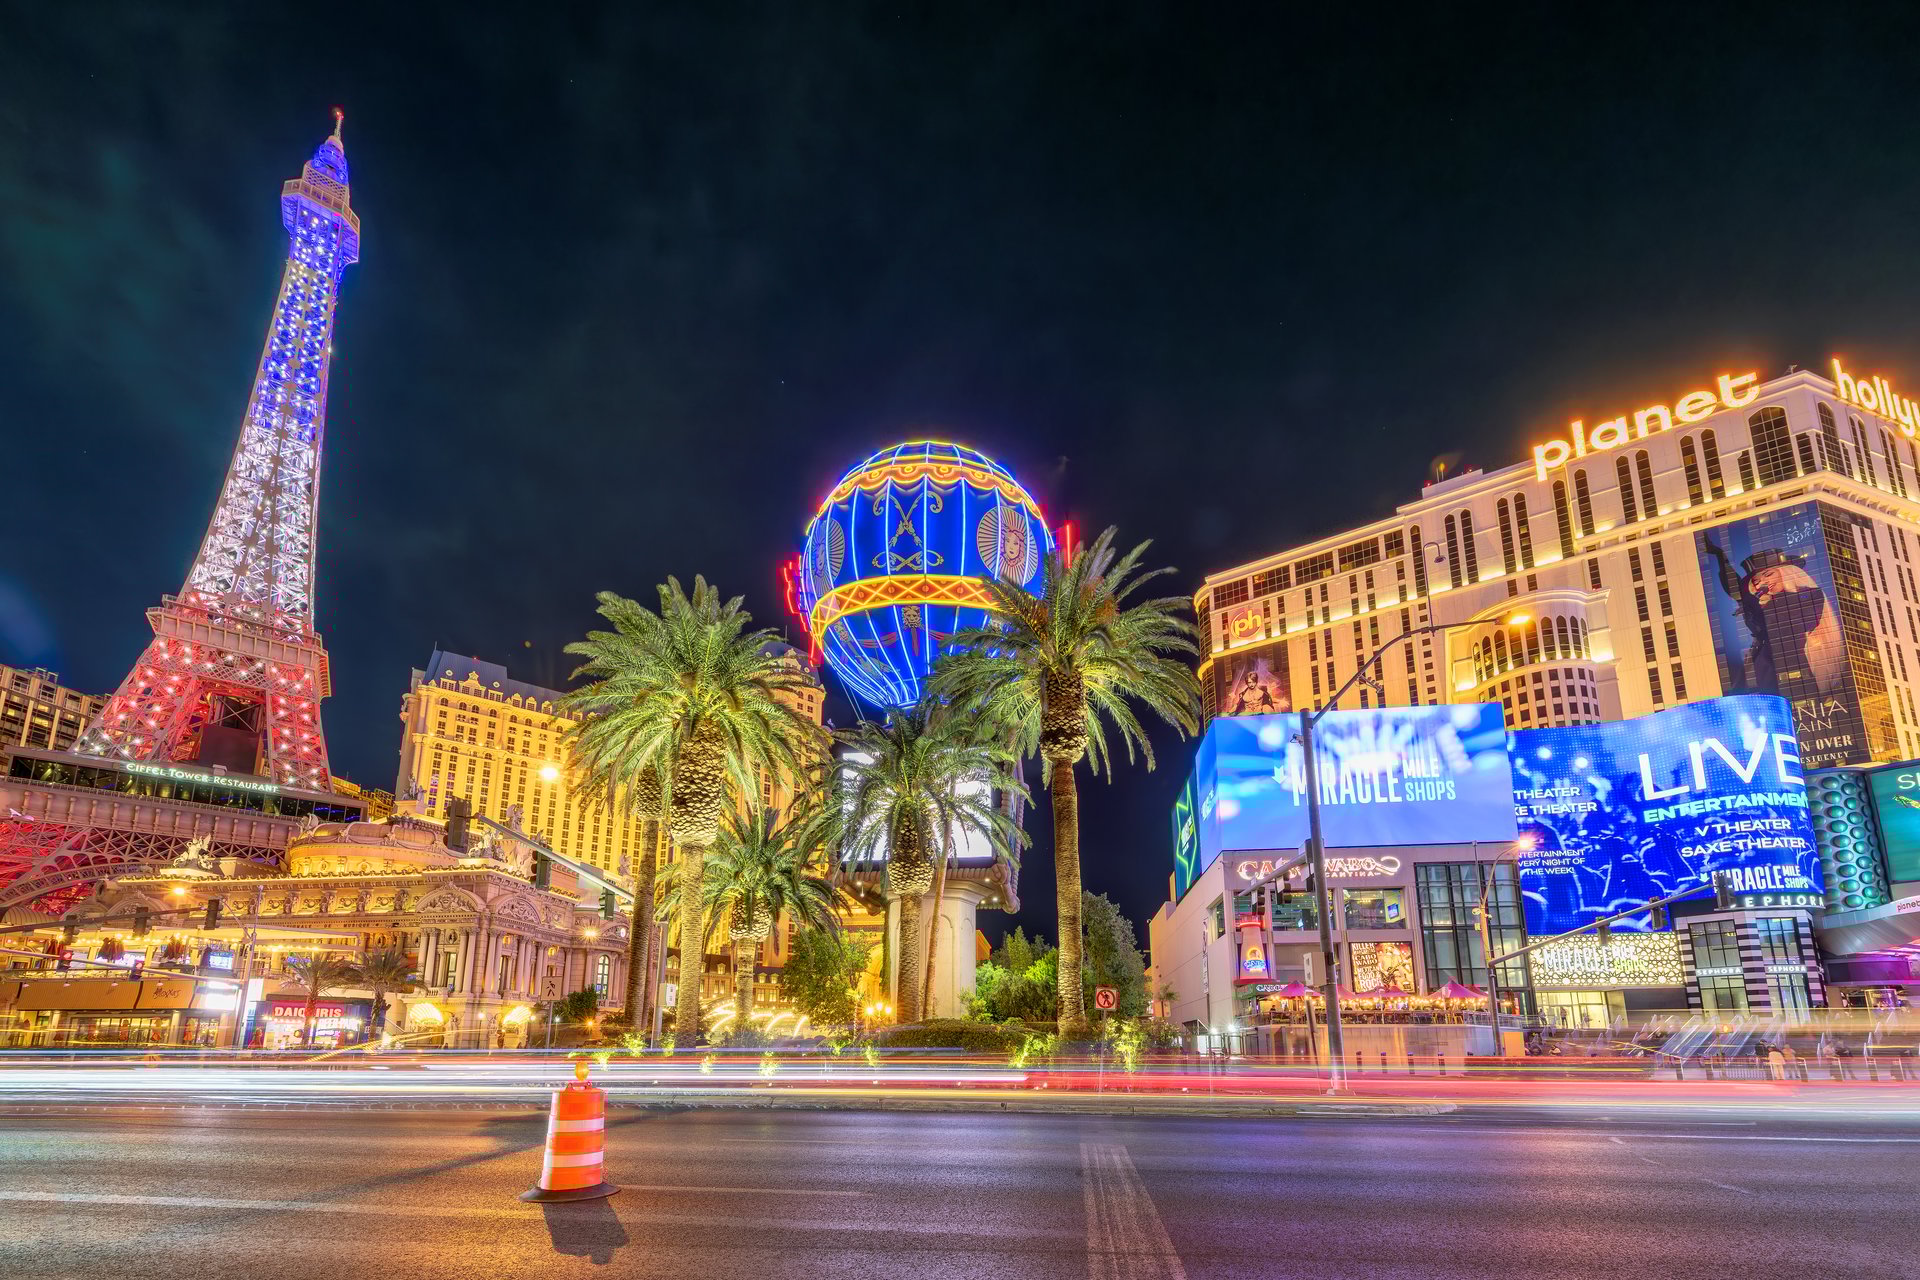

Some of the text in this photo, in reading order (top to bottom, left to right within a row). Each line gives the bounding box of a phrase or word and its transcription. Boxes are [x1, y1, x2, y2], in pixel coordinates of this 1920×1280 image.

[1533, 371, 1761, 482] planet
[1235, 609, 1262, 638] ph
[1793, 699, 1848, 721] NIA
[1796, 718, 1832, 734] AIN
[1815, 734, 1853, 750] OVER
[1800, 751, 1849, 764] ESIDENCY
[1402, 757, 1441, 779] MILE
[1638, 732, 1804, 801] LIVE
[126, 762, 279, 793] EIFFEL TOWER RESTAURANT
[1404, 780, 1457, 802] SHOPS
[1513, 786, 1581, 800] THEATER
[1529, 801, 1598, 815] THEATER
[1643, 790, 1809, 823] ENTERTAINMEN
[1694, 818, 1791, 837] V THEATER
[1681, 836, 1806, 858] SAXE THEATER
[1541, 857, 1571, 866] NIGHT
[1572, 857, 1586, 865] OF
[1782, 864, 1801, 876] MILE
[1711, 865, 1809, 893] RACLE SHOPS
[1730, 895, 1825, 909] EPHORA
[1355, 953, 1377, 961] CABO
[1355, 959, 1378, 967] WABO
[1543, 946, 1611, 973] MIRACLE
[1696, 967, 1742, 975] SEPHORA
[1767, 965, 1807, 973] SEPHORA
[274, 1006, 342, 1018] DAIQIRIS
